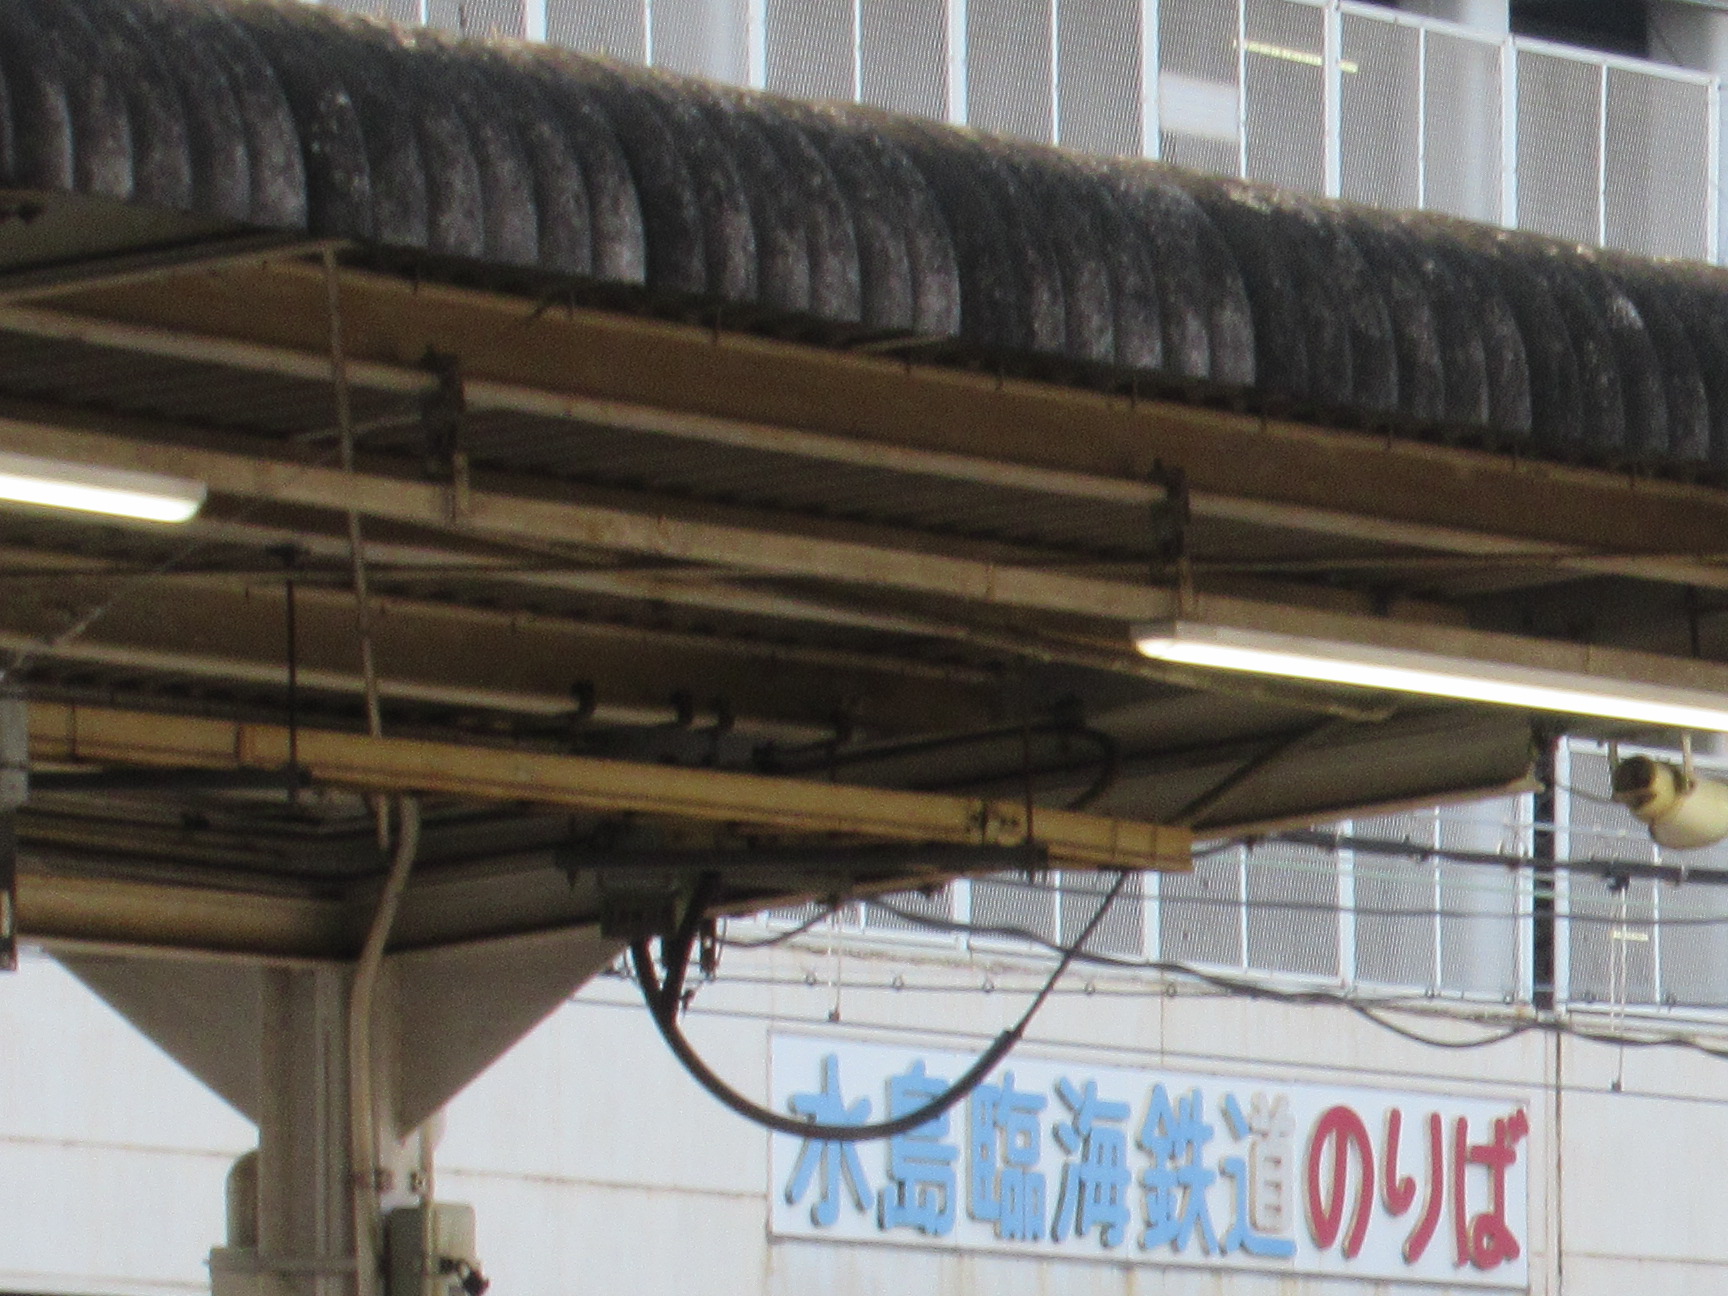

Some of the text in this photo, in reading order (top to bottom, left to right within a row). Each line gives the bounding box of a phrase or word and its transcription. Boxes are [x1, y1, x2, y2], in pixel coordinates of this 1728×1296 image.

[784, 1052, 1530, 1270] 水島臨海鉄道のりば
